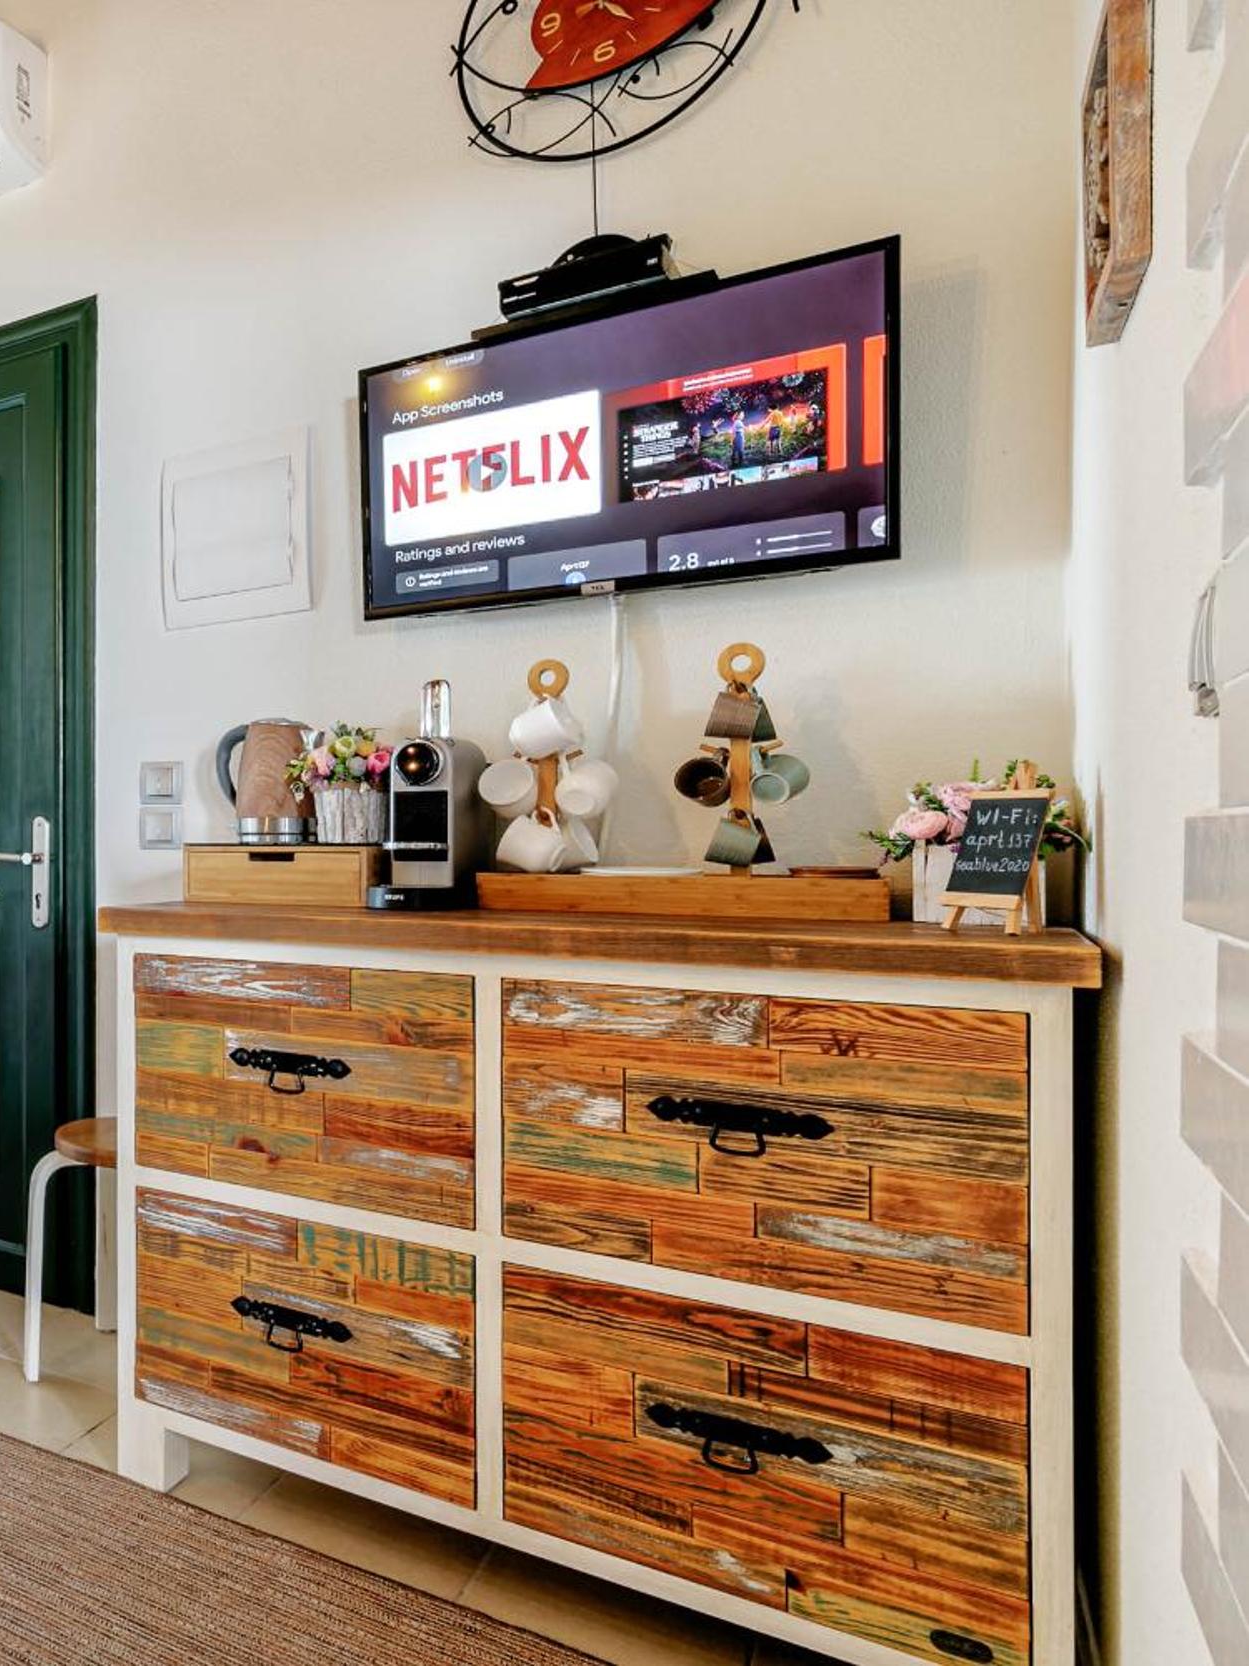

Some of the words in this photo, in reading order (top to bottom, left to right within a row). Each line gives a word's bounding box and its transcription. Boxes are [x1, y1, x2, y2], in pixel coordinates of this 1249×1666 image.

[540, 12, 561, 38] 9
[593, 39, 616, 63] 6
[392, 410, 419, 425] App
[421, 390, 504, 418] Screenshots
[392, 426, 590, 513] NETFLIX
[395, 548, 442, 563] Ratings
[445, 541, 470, 556] and
[472, 535, 525, 552] reviews
[669, 552, 699, 571] 2.8
